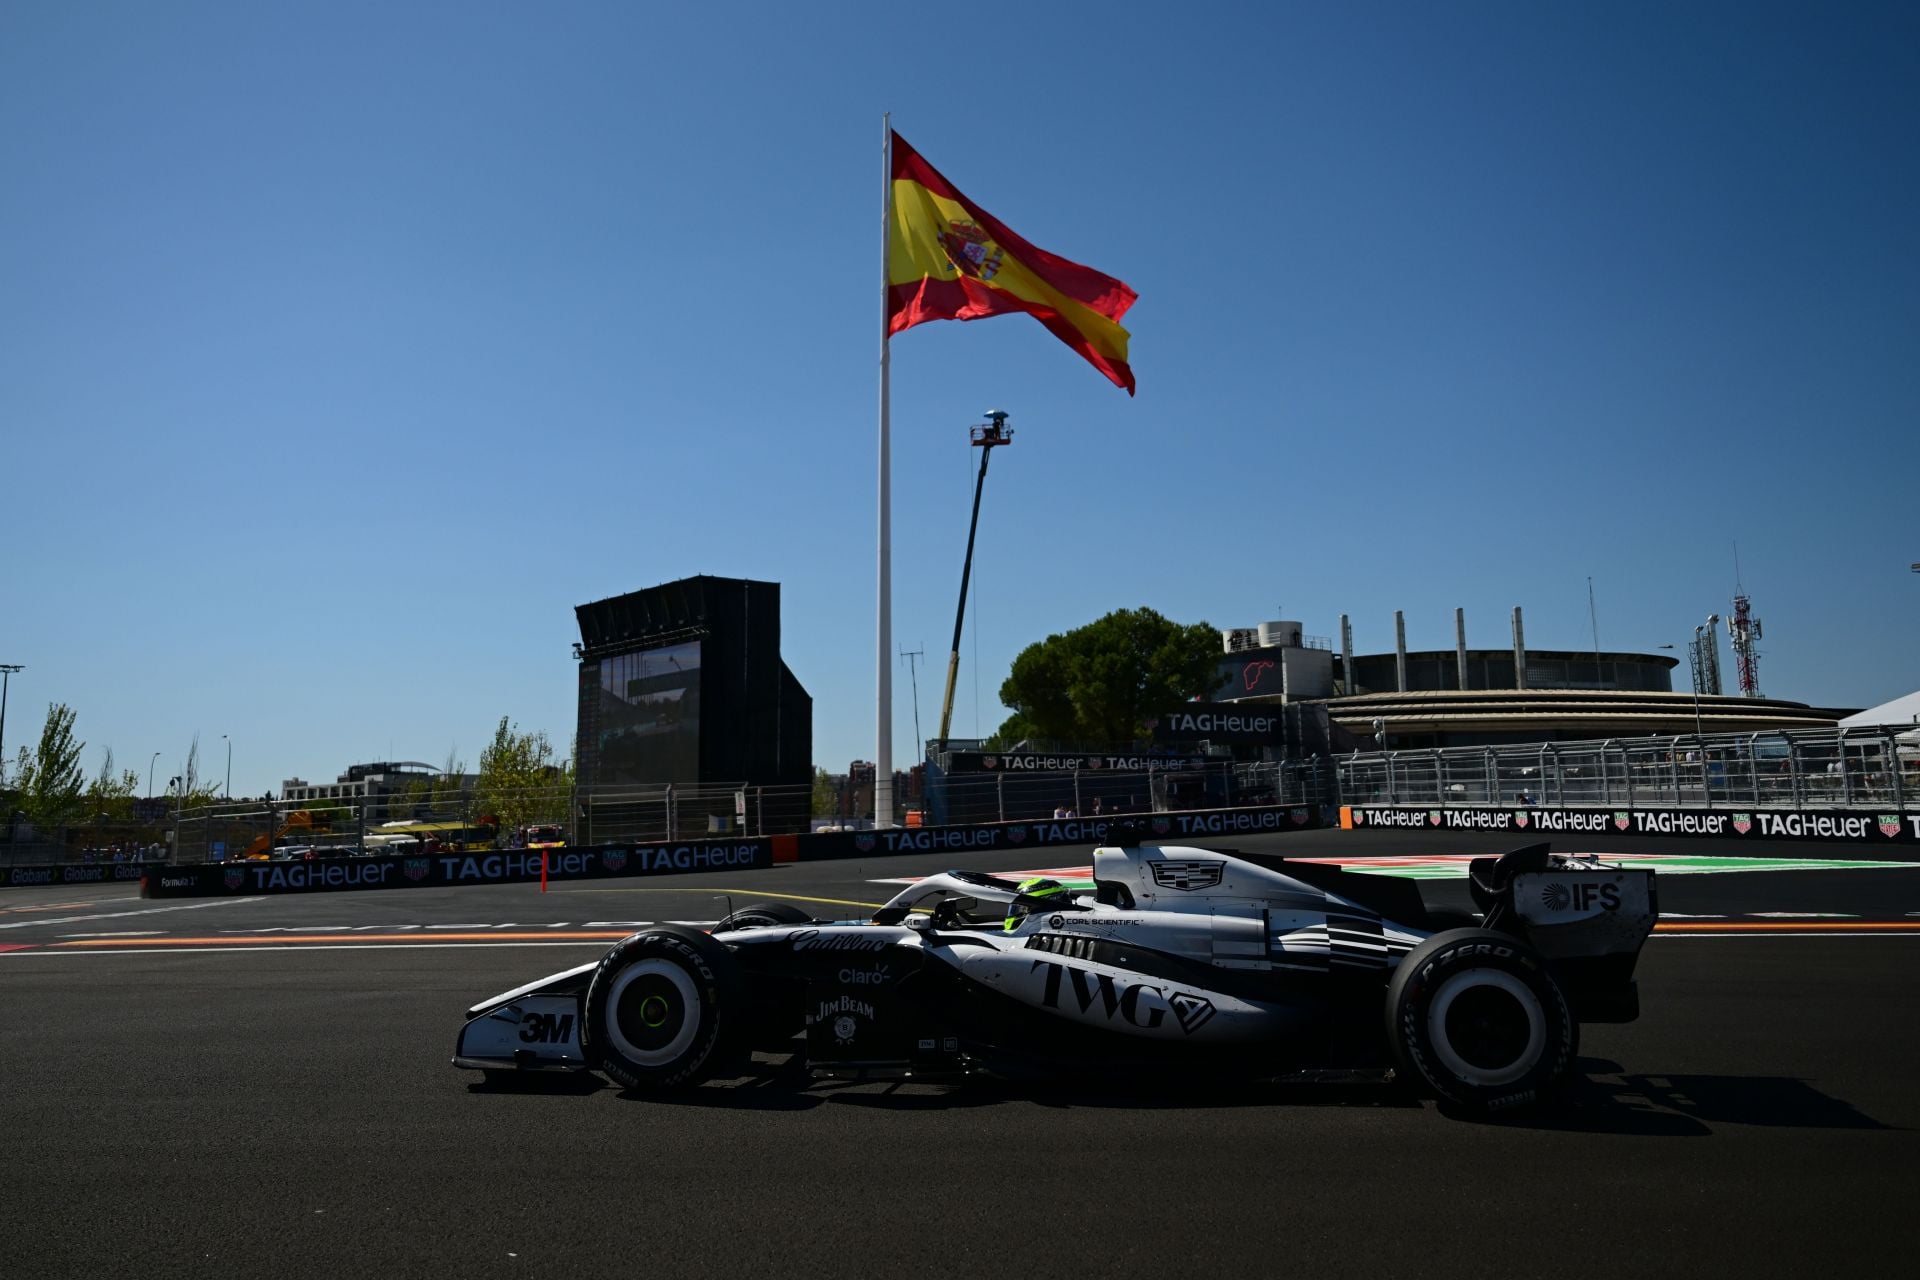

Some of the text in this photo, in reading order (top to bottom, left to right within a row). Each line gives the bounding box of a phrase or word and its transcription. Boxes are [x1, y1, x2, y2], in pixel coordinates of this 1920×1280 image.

[1880, 816, 1898, 824] TAG
[11, 868, 51, 884] Globant
[64, 866, 103, 881] Globant
[161, 877, 189, 888] Formula
[1572, 883, 1621, 911] IFS
[644, 935, 659, 945] P
[789, 929, 886, 951] Cadillac
[1421, 944, 1514, 981] P ZERO
[838, 966, 884, 985] Claro
[1030, 959, 1167, 1028] TWG
[816, 995, 875, 1021] JIM BEAM
[519, 1012, 575, 1044] 3M
